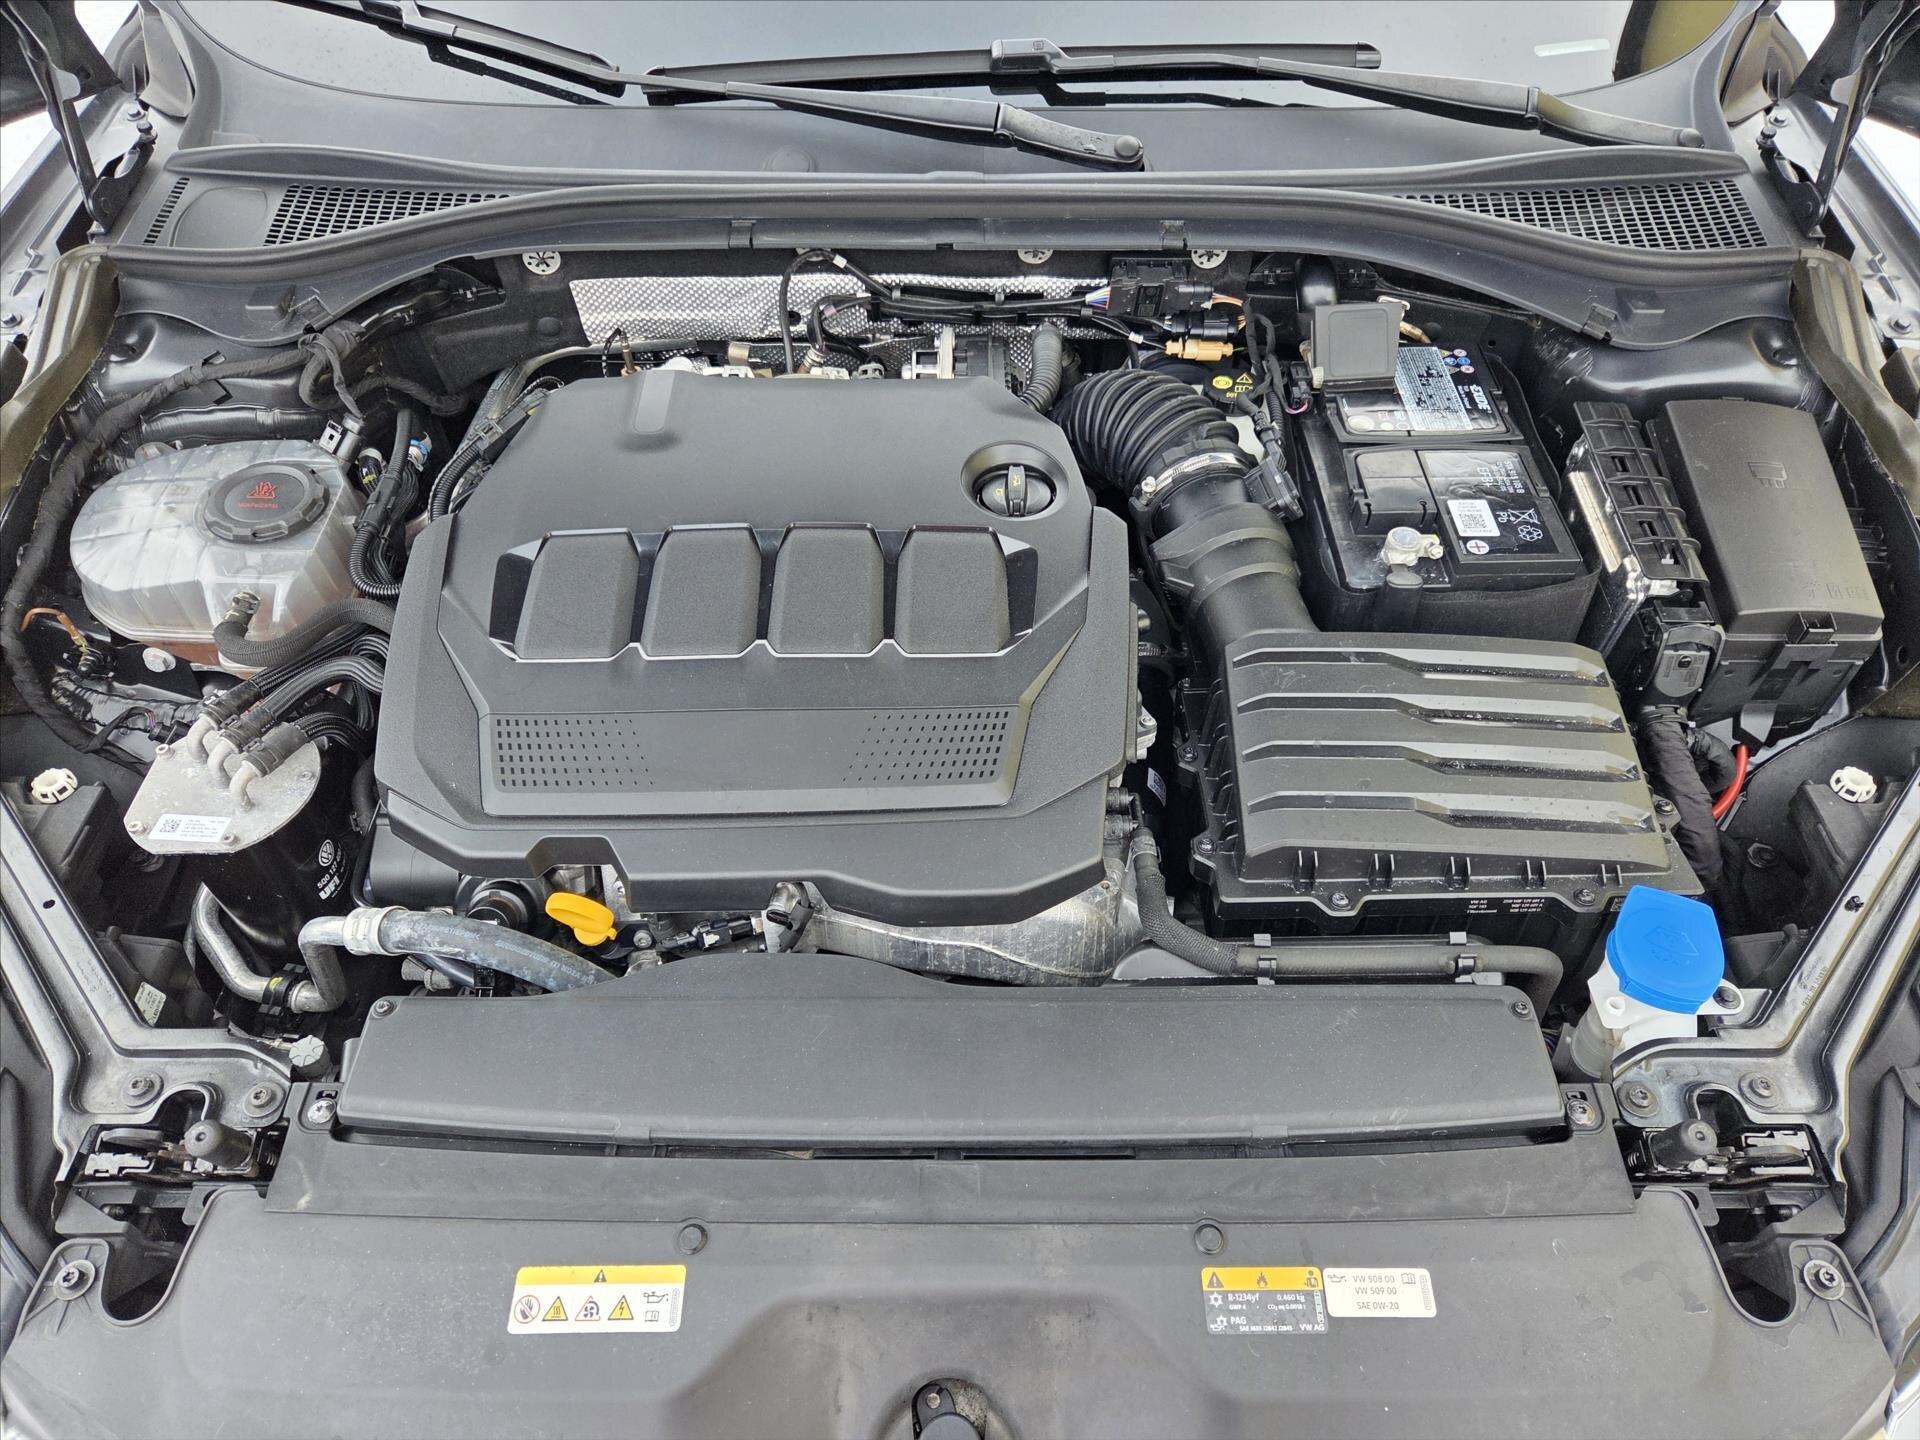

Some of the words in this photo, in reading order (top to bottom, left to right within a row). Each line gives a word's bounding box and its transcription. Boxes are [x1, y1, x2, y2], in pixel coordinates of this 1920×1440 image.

[1469, 384, 1491, 410] EXIDE
[1477, 467, 1494, 488] EFB+
[1495, 511, 1508, 523] Pb
[319, 875, 340, 900] UFI
[1352, 1275, 1366, 1283] VW
[1368, 1275, 1383, 1283] 508
[1384, 1275, 1395, 1283] 00
[1354, 1287, 1368, 1295] VW
[1370, 1287, 1385, 1295] 509
[1386, 1287, 1397, 1295] 00
[1228, 1293, 1260, 1303] R-1234yf
[1296, 1293, 1306, 1303] kg
[1357, 1301, 1371, 1310] SAE
[1373, 1301, 1399, 1310] 0W-20
[1230, 1316, 1247, 1325] PAG
[1299, 1323, 1312, 1331] VW
[1314, 1323, 1326, 1331] AG
